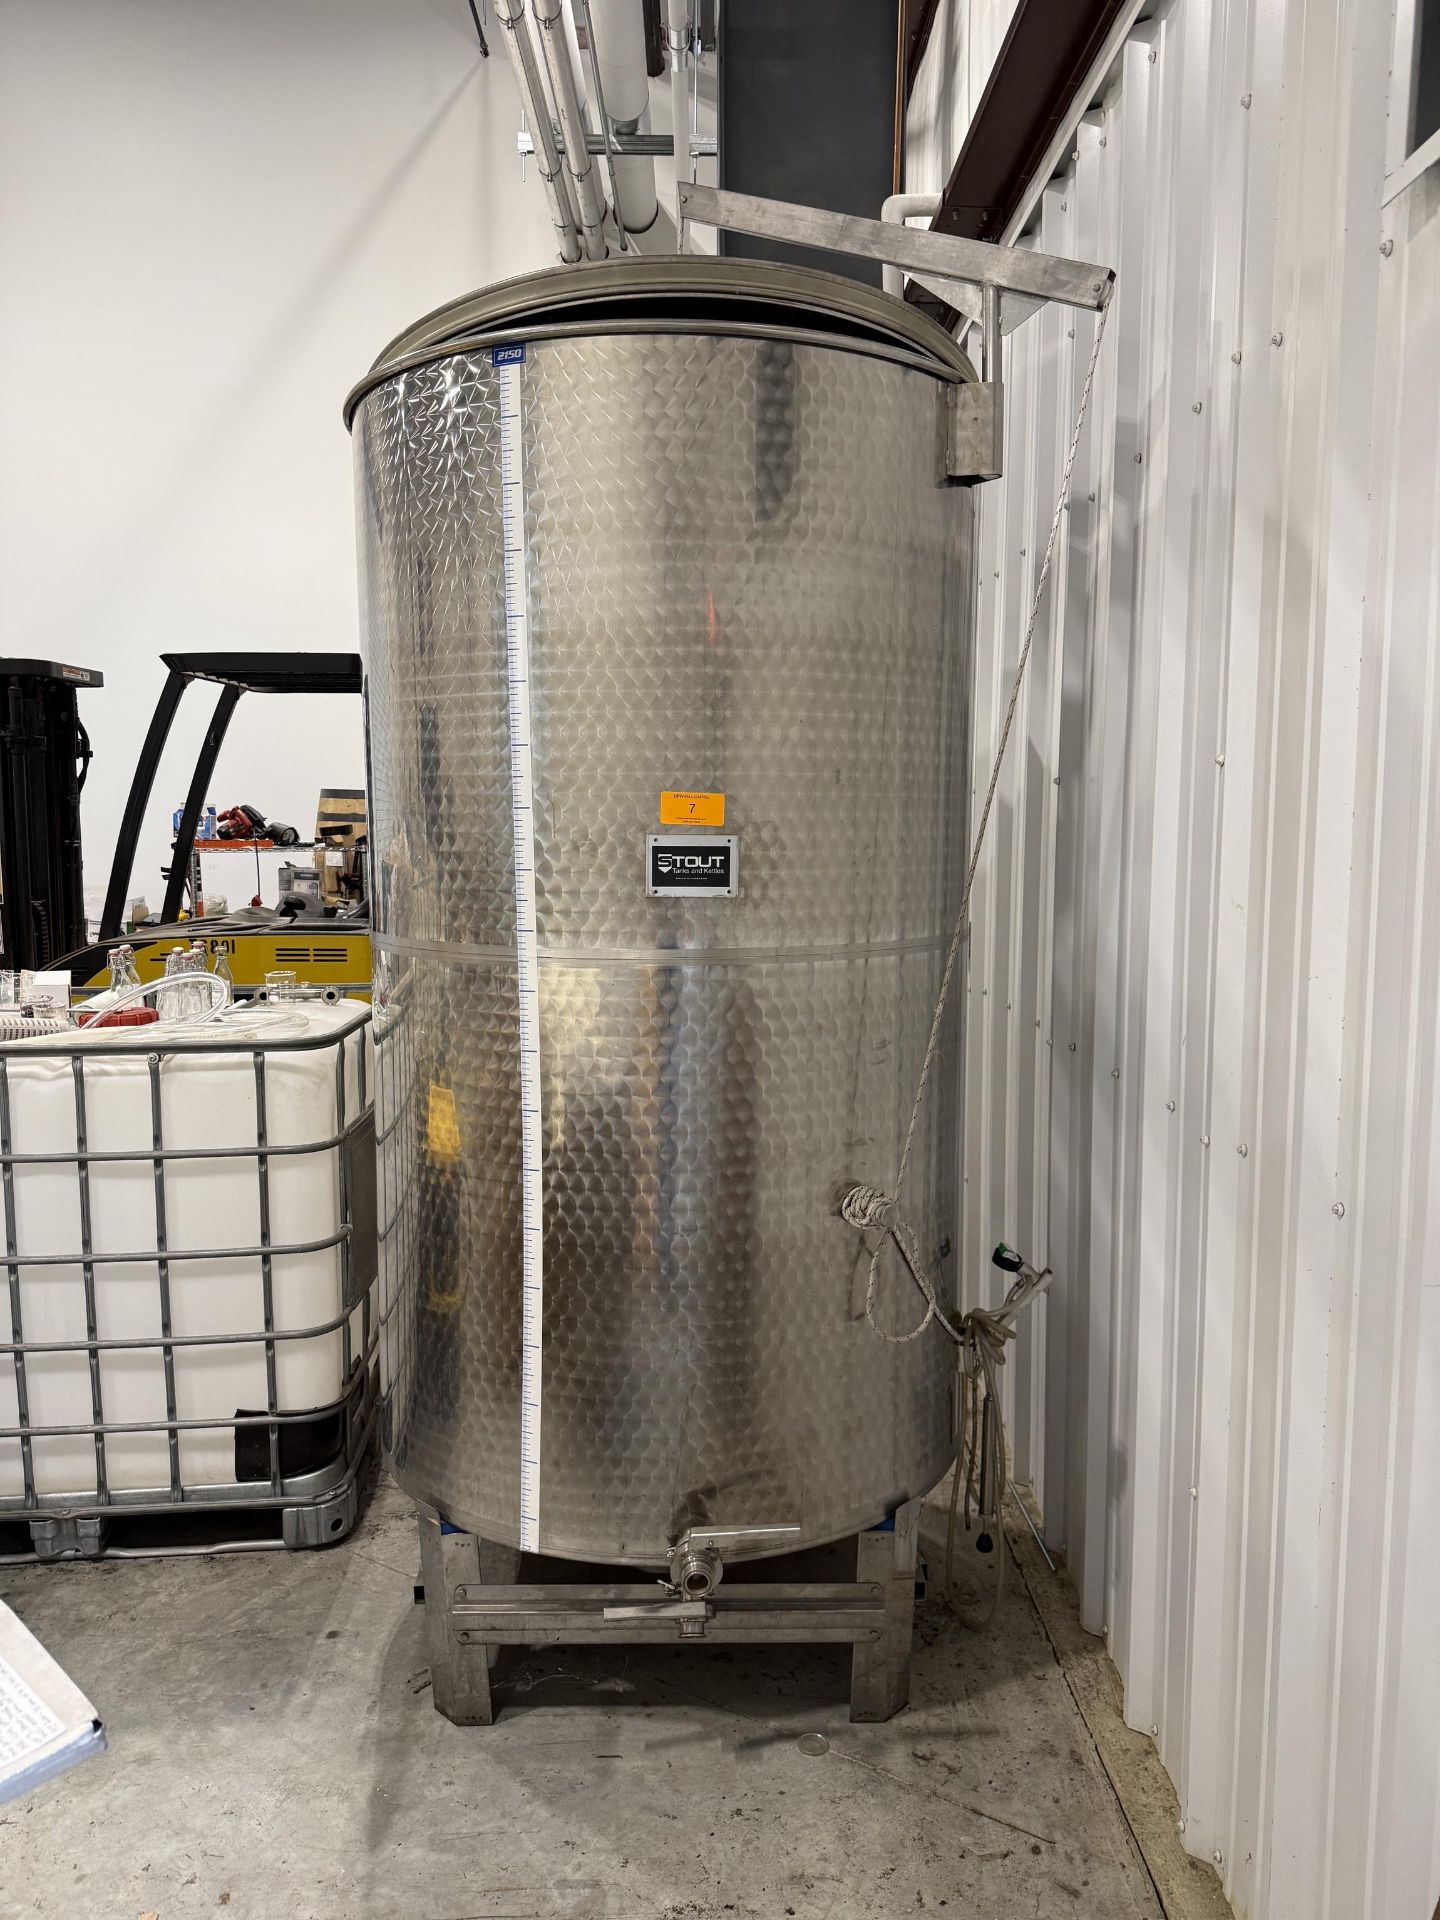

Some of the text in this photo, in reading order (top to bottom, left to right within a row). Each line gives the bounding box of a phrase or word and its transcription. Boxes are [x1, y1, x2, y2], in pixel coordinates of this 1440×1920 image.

[497, 348, 522, 360] 2150
[689, 803, 696, 814] 7
[657, 853, 725, 869] STOUT
